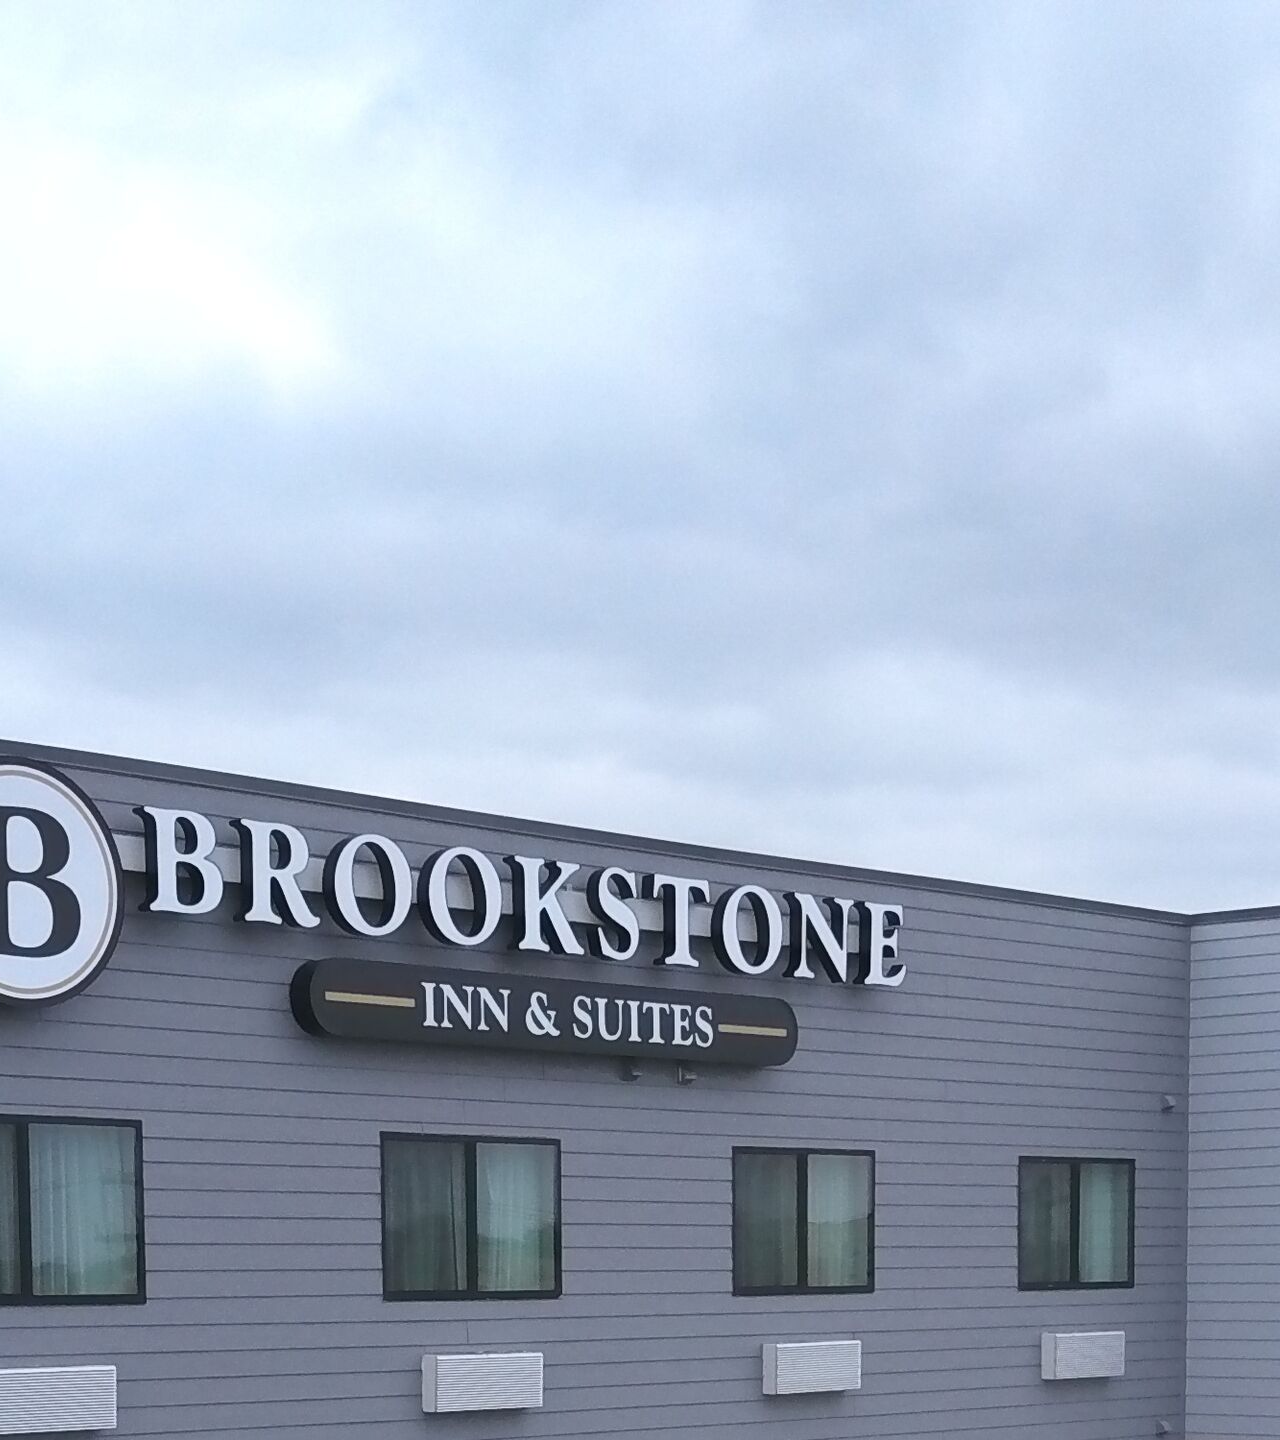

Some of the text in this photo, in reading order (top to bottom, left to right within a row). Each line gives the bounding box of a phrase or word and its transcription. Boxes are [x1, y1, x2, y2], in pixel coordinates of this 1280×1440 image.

[135, 805, 907, 987] BROOKSTONE
[421, 982, 714, 1048] INN & SUITES
